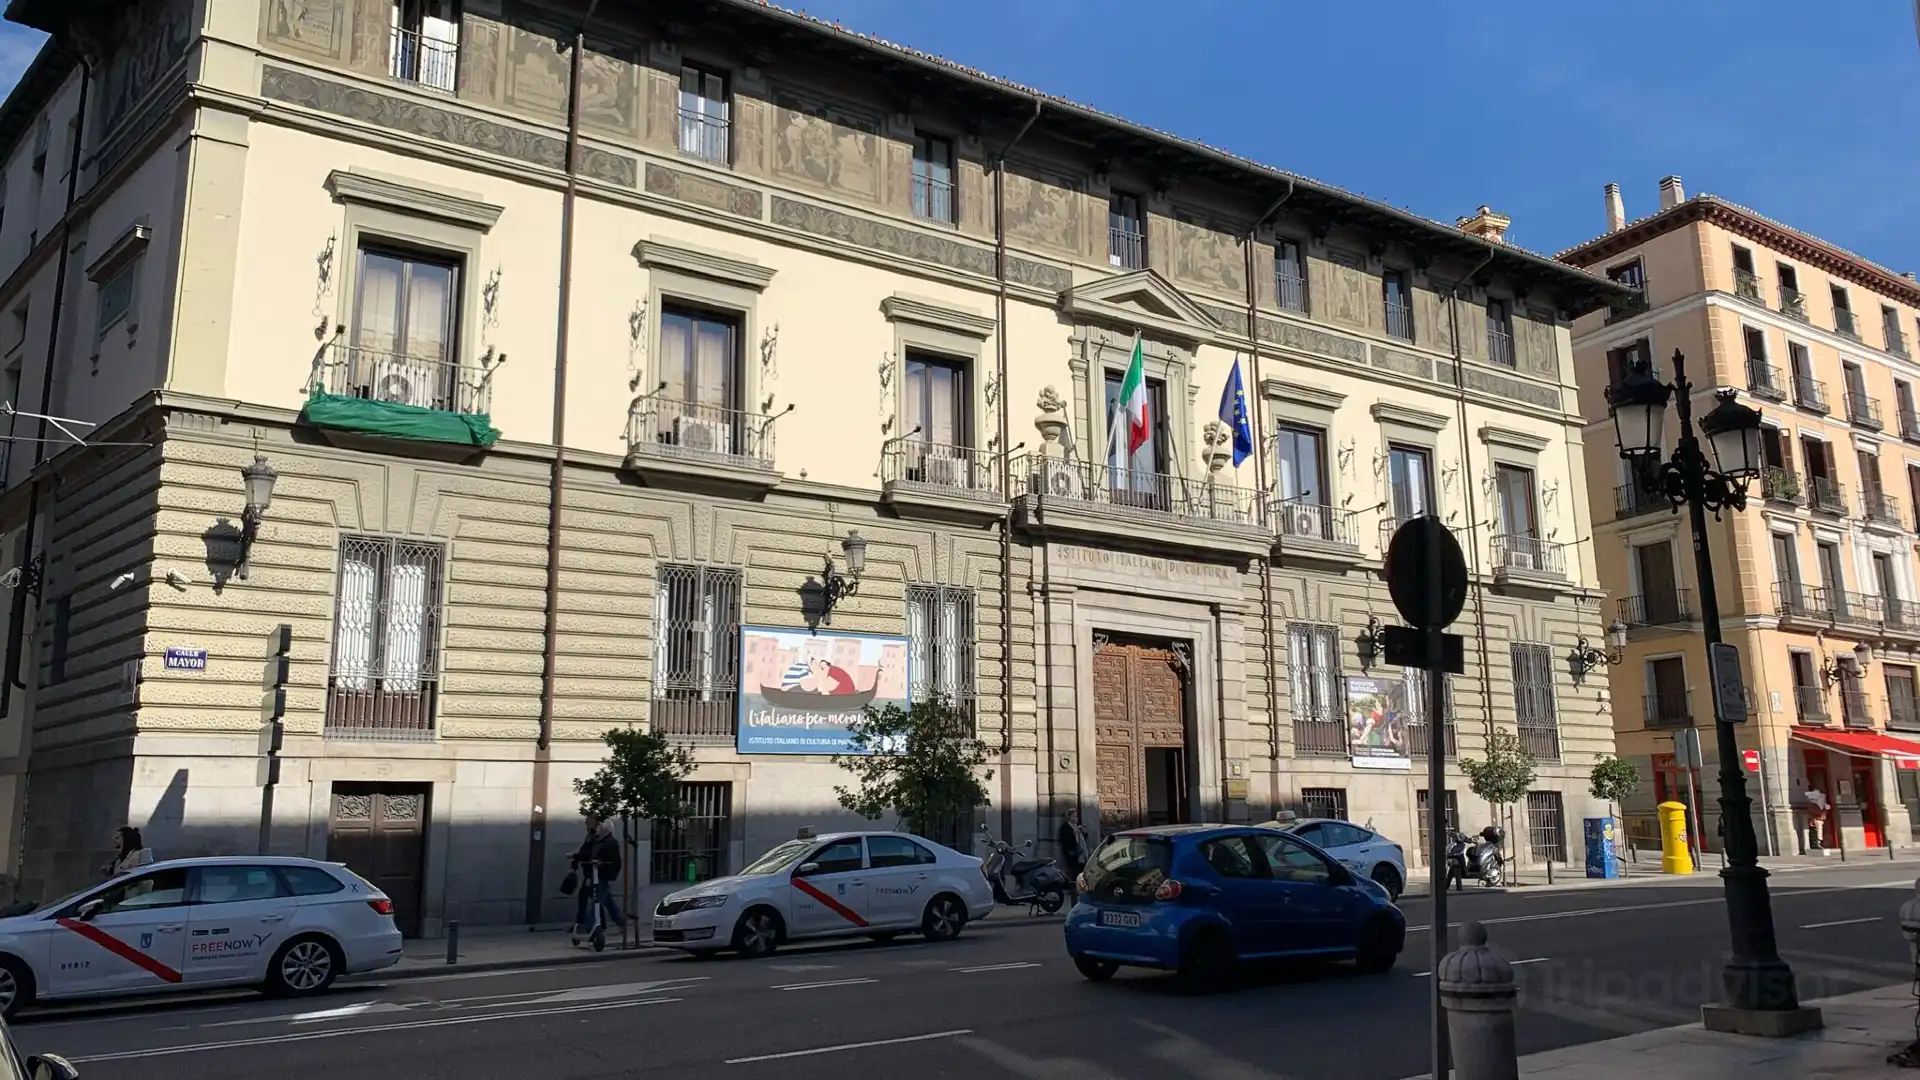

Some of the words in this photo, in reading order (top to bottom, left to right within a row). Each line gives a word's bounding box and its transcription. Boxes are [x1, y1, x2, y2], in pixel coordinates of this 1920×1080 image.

[1115, 554, 1162, 571] ITALIANO
[1184, 563, 1229, 580] CULTURA
[168, 657, 204, 668] MAYOR
[804, 712, 826, 729] per
[749, 737, 774, 745] ISTITUTO
[775, 738, 800, 746] ITALIANO
[807, 738, 831, 746] CULTURA
